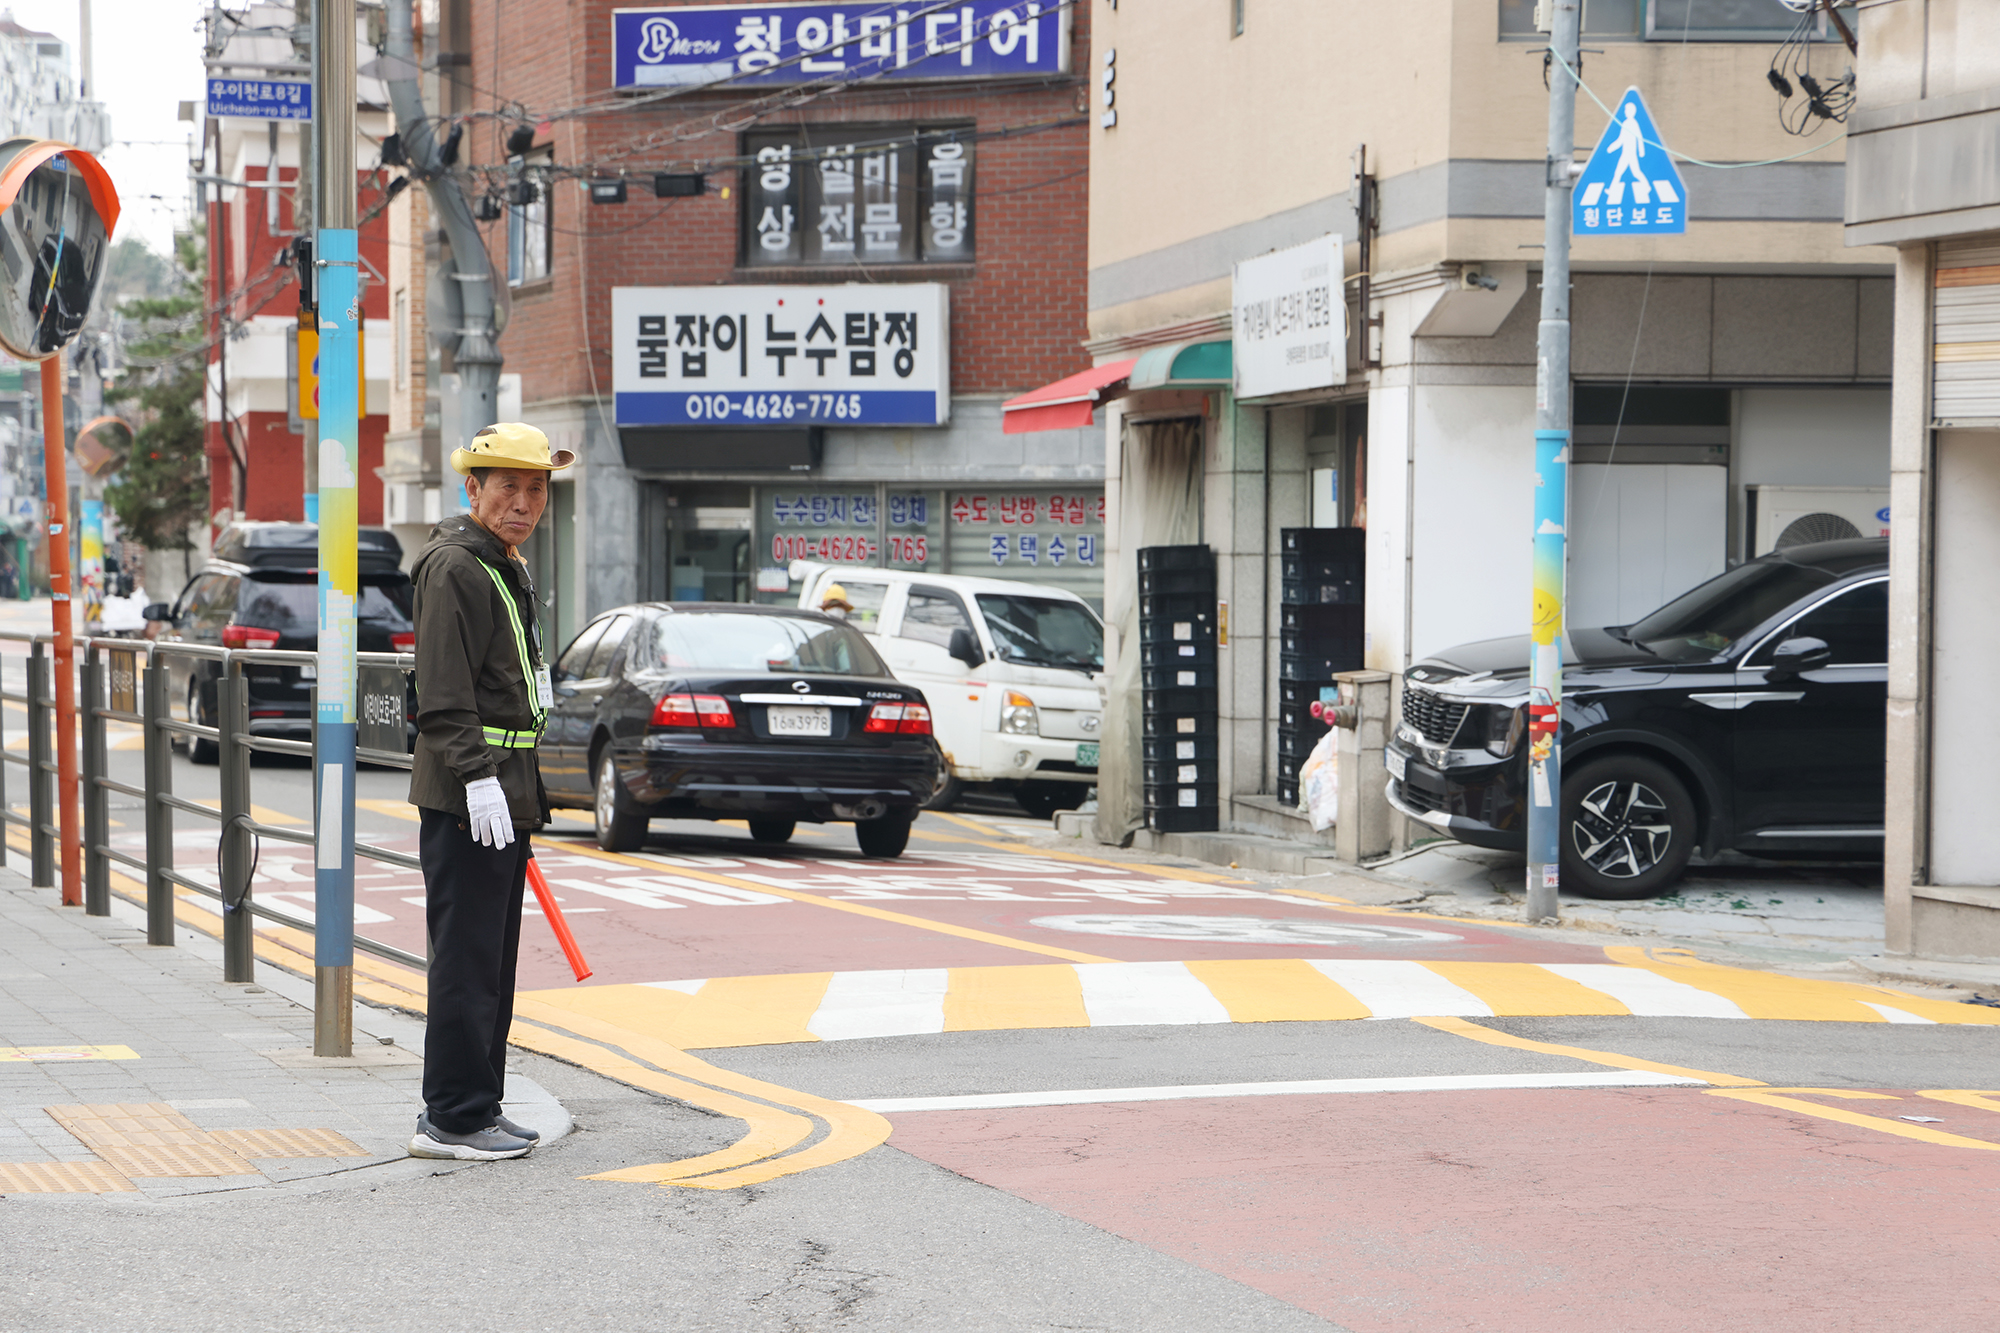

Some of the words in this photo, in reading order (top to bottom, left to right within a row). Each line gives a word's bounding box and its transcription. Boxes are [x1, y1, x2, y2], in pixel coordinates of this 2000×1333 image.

[732, 3, 1040, 76] 청안미디어
[210, 81, 302, 104] 우이천로8길
[210, 102, 279, 117] Uicheon-ro
[280, 104, 308, 119] 8-gil
[816, 202, 902, 251] 전문
[1583, 206, 1675, 228] 횡단보도
[1306, 284, 1330, 329] 전문점
[637, 313, 748, 378] 물잡이
[765, 312, 918, 378] 누수탐정
[685, 394, 862, 419] 010-4626-7765
[773, 495, 847, 526] 누수탐지
[773, 536, 927, 563] 010-4626-765
[991, 535, 1095, 564] 주택수리
[363, 692, 403, 728] 어린이보호구역
